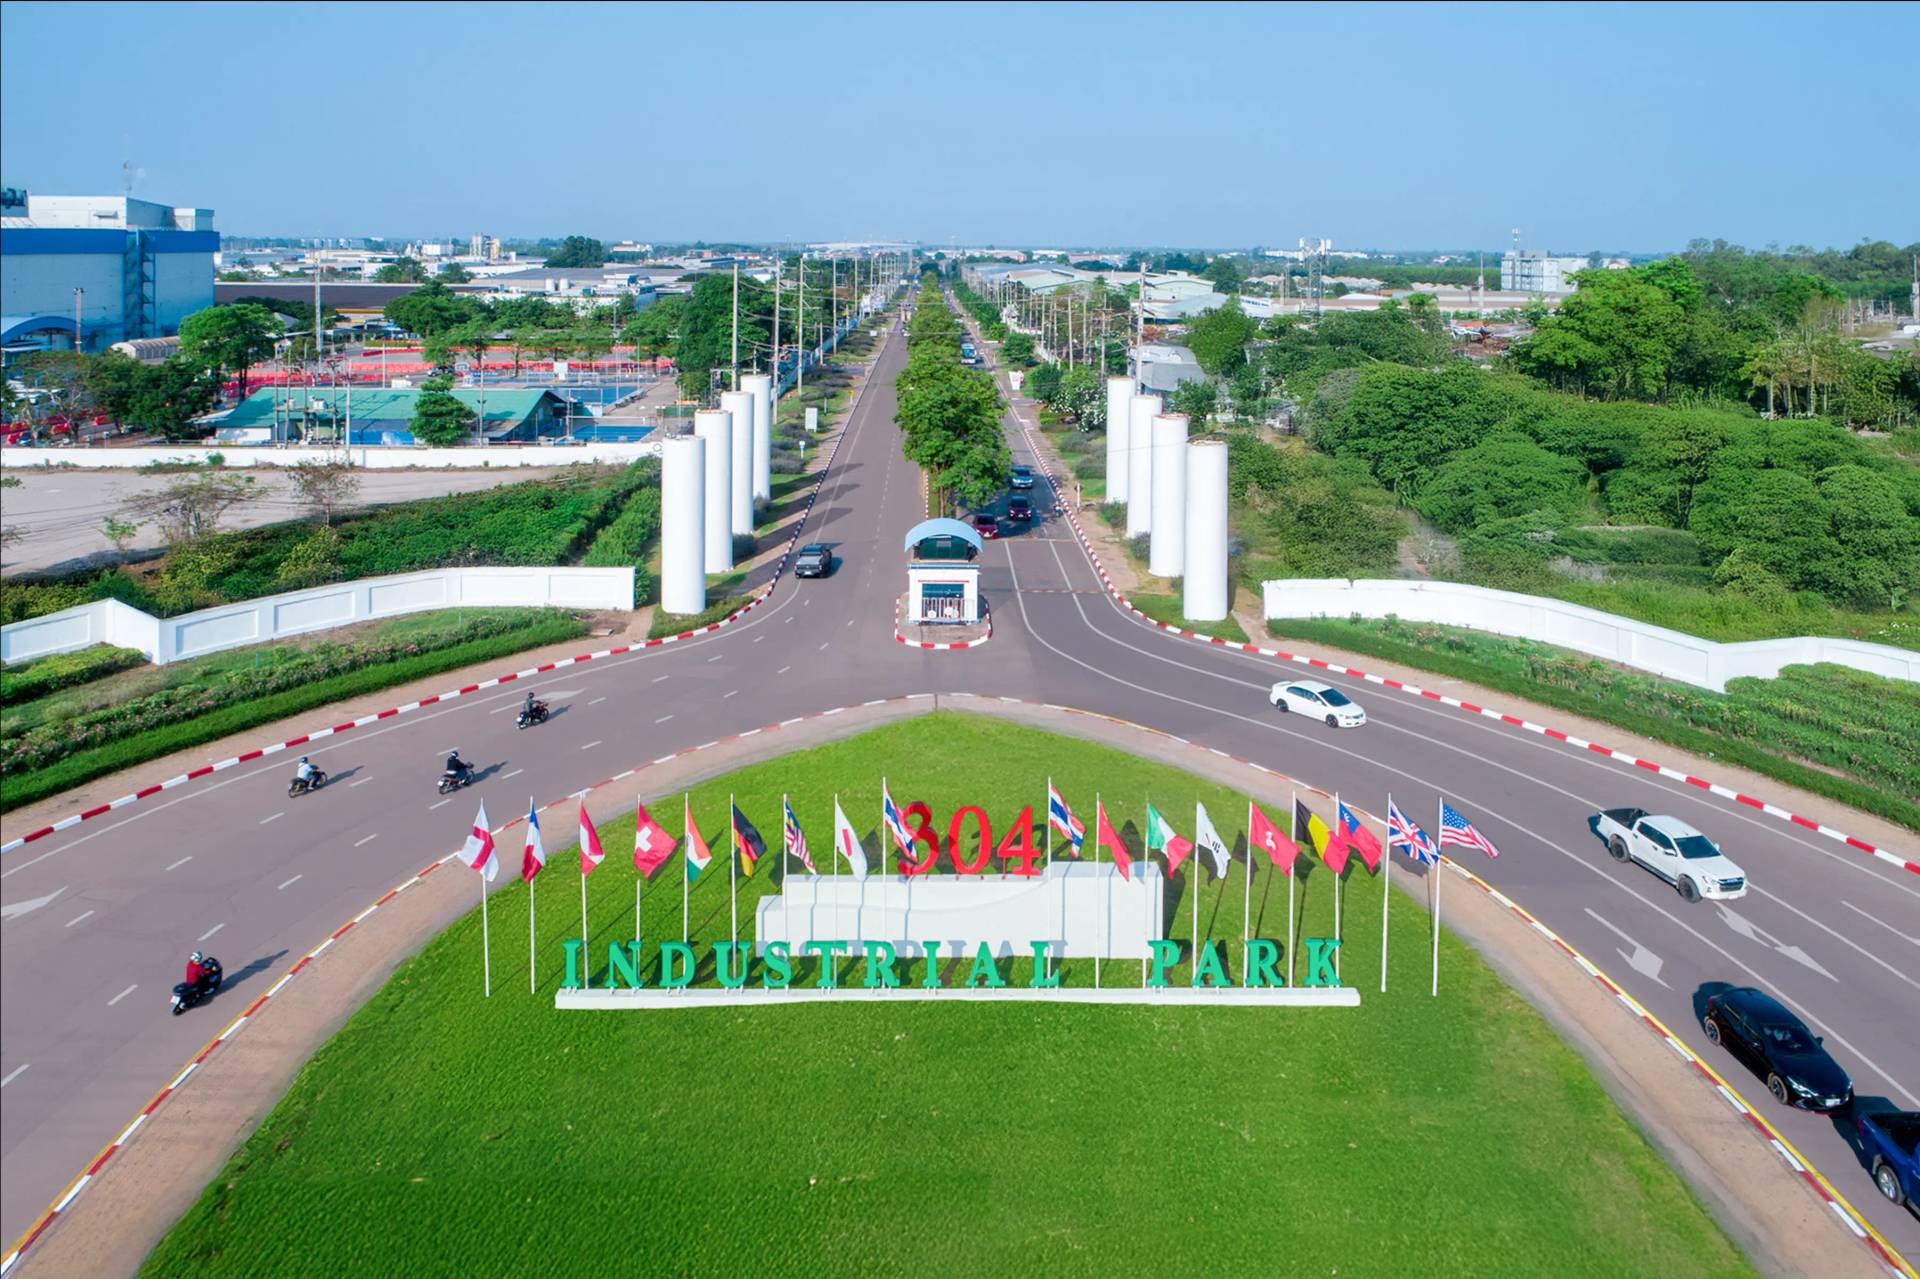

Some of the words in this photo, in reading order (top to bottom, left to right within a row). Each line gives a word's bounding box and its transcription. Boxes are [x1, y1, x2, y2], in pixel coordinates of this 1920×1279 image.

[898, 801, 1041, 877] 304
[561, 938, 1060, 988] INDUSTRIAL
[1146, 938, 1342, 987] PARK
